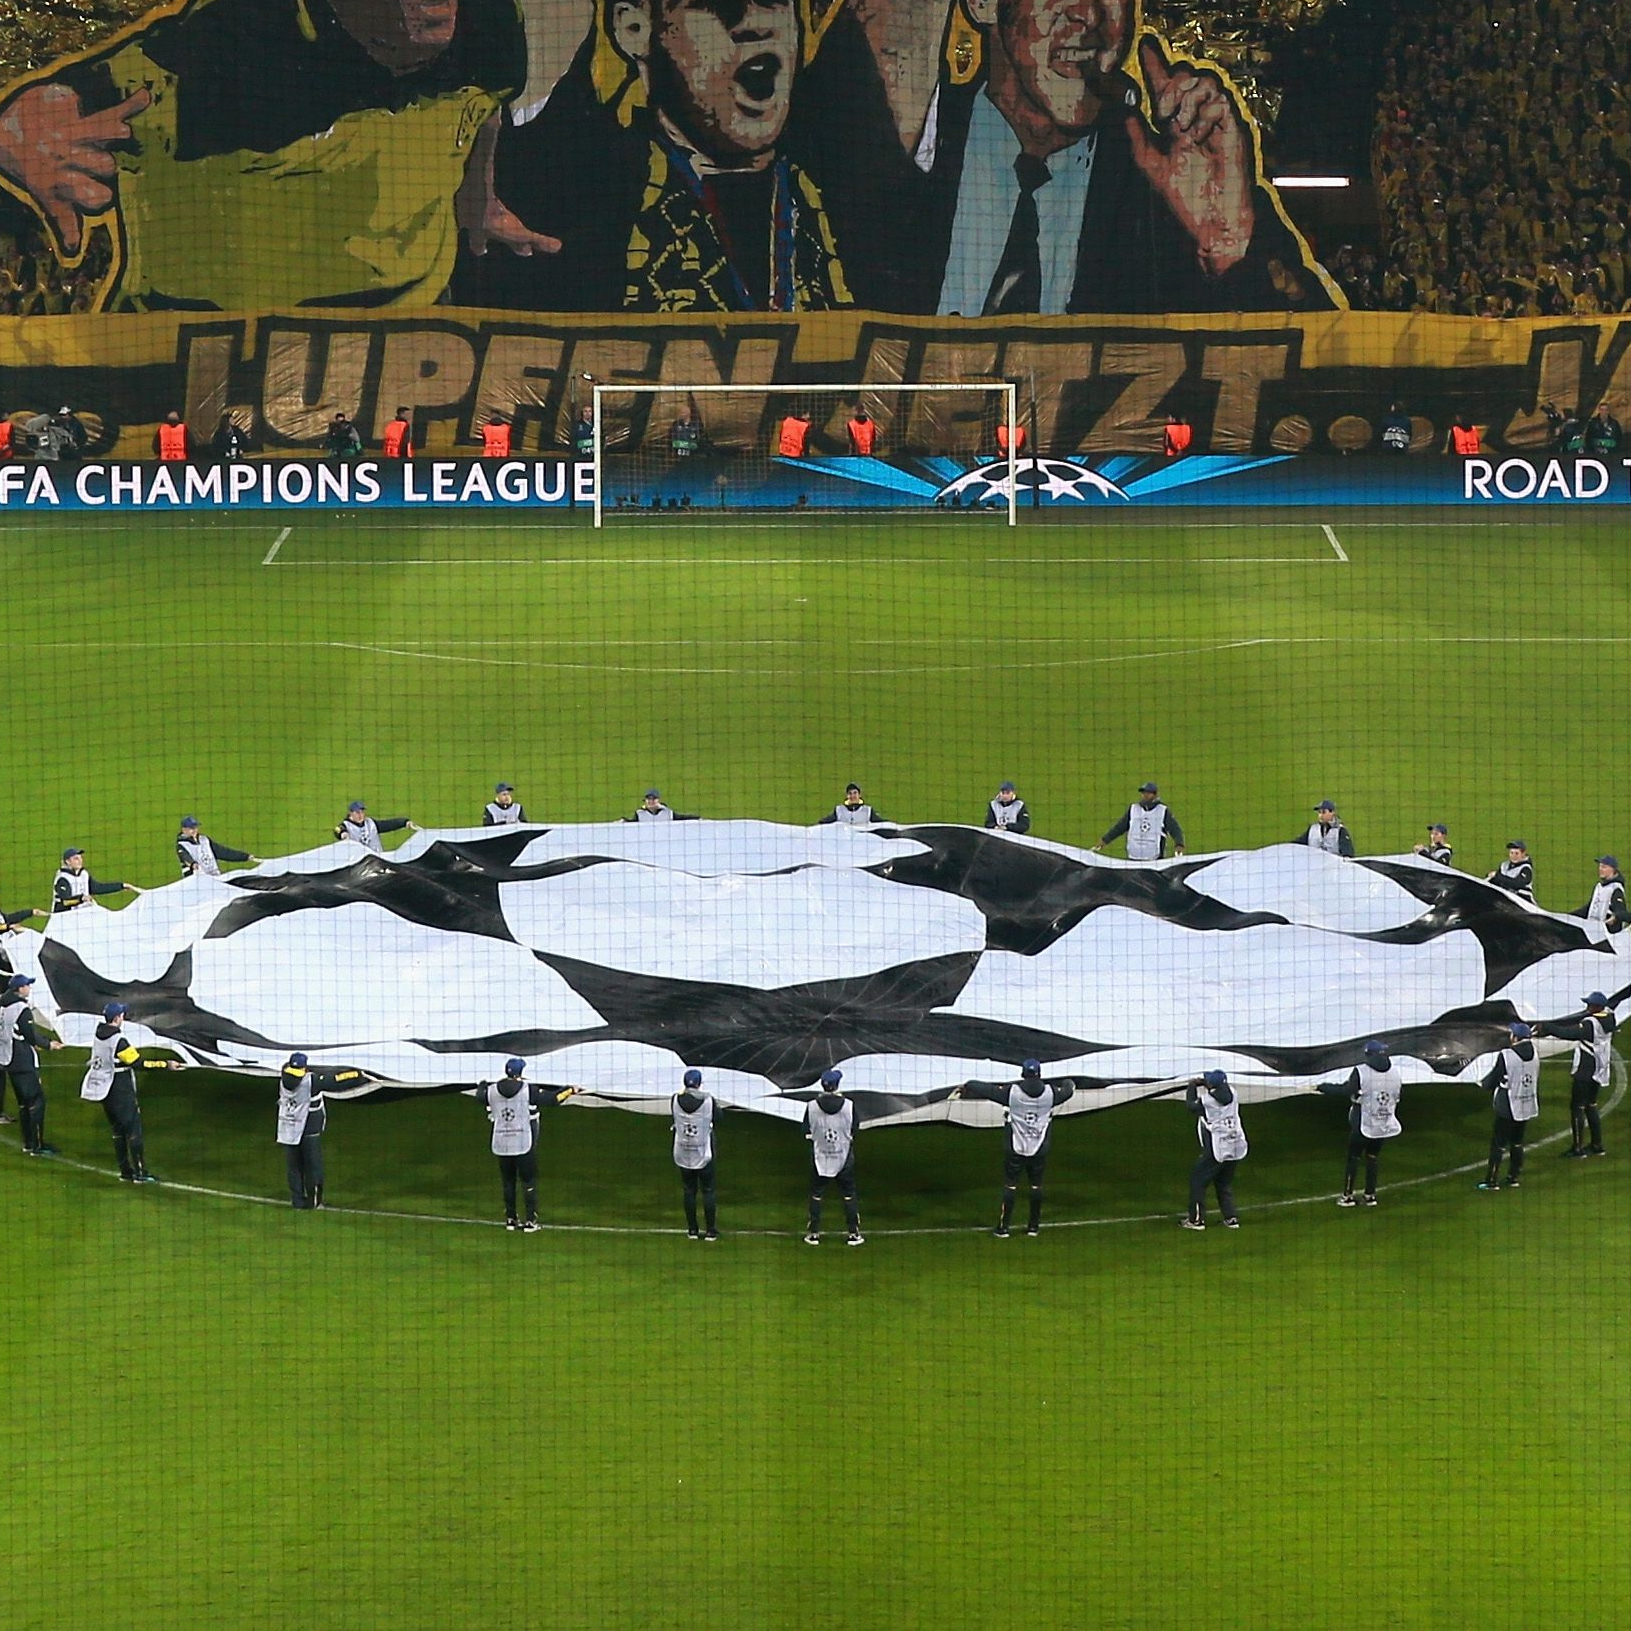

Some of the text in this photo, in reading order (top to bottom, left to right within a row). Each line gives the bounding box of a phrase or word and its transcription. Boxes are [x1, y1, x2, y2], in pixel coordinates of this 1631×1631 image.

[75, 462, 382, 505] CHAMPIONS
[402, 461, 597, 503] LEAGUE
[1464, 458, 1610, 500] ROAD
